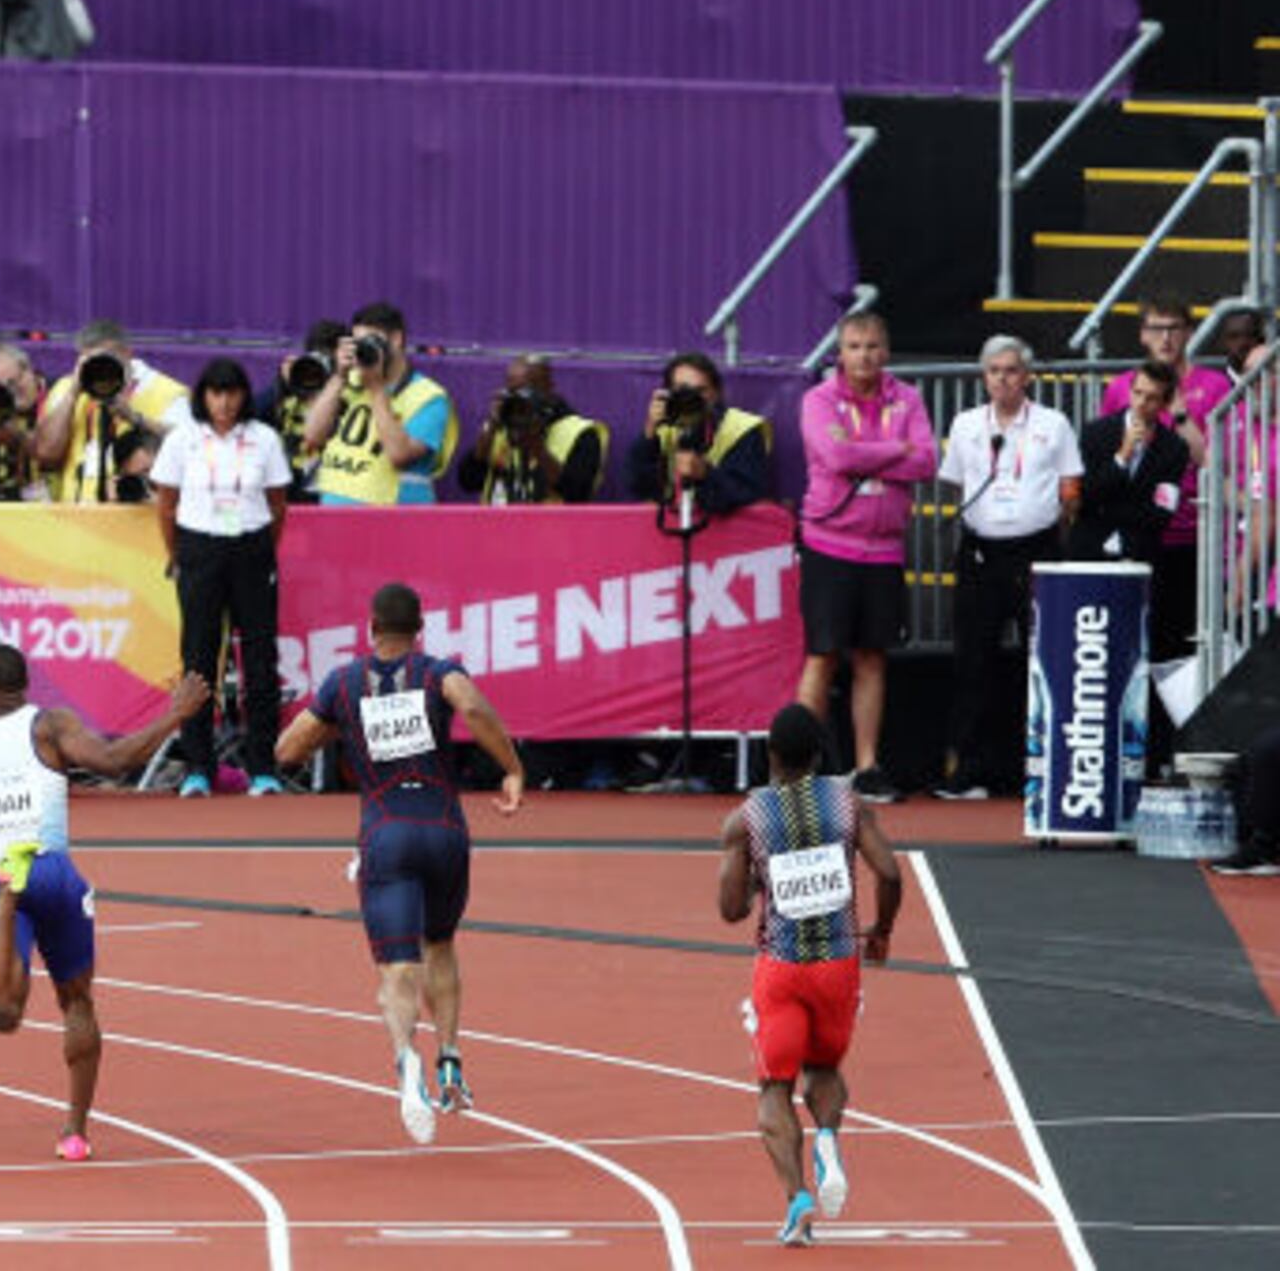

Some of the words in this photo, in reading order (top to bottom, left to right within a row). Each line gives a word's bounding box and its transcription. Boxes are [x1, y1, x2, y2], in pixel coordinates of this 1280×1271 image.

[28, 617, 131, 660] 2017
[410, 594, 540, 678] HE
[554, 543, 797, 662] NEXT
[1060, 605, 1110, 819] Strathmore
[776, 869, 845, 901] GREENE
